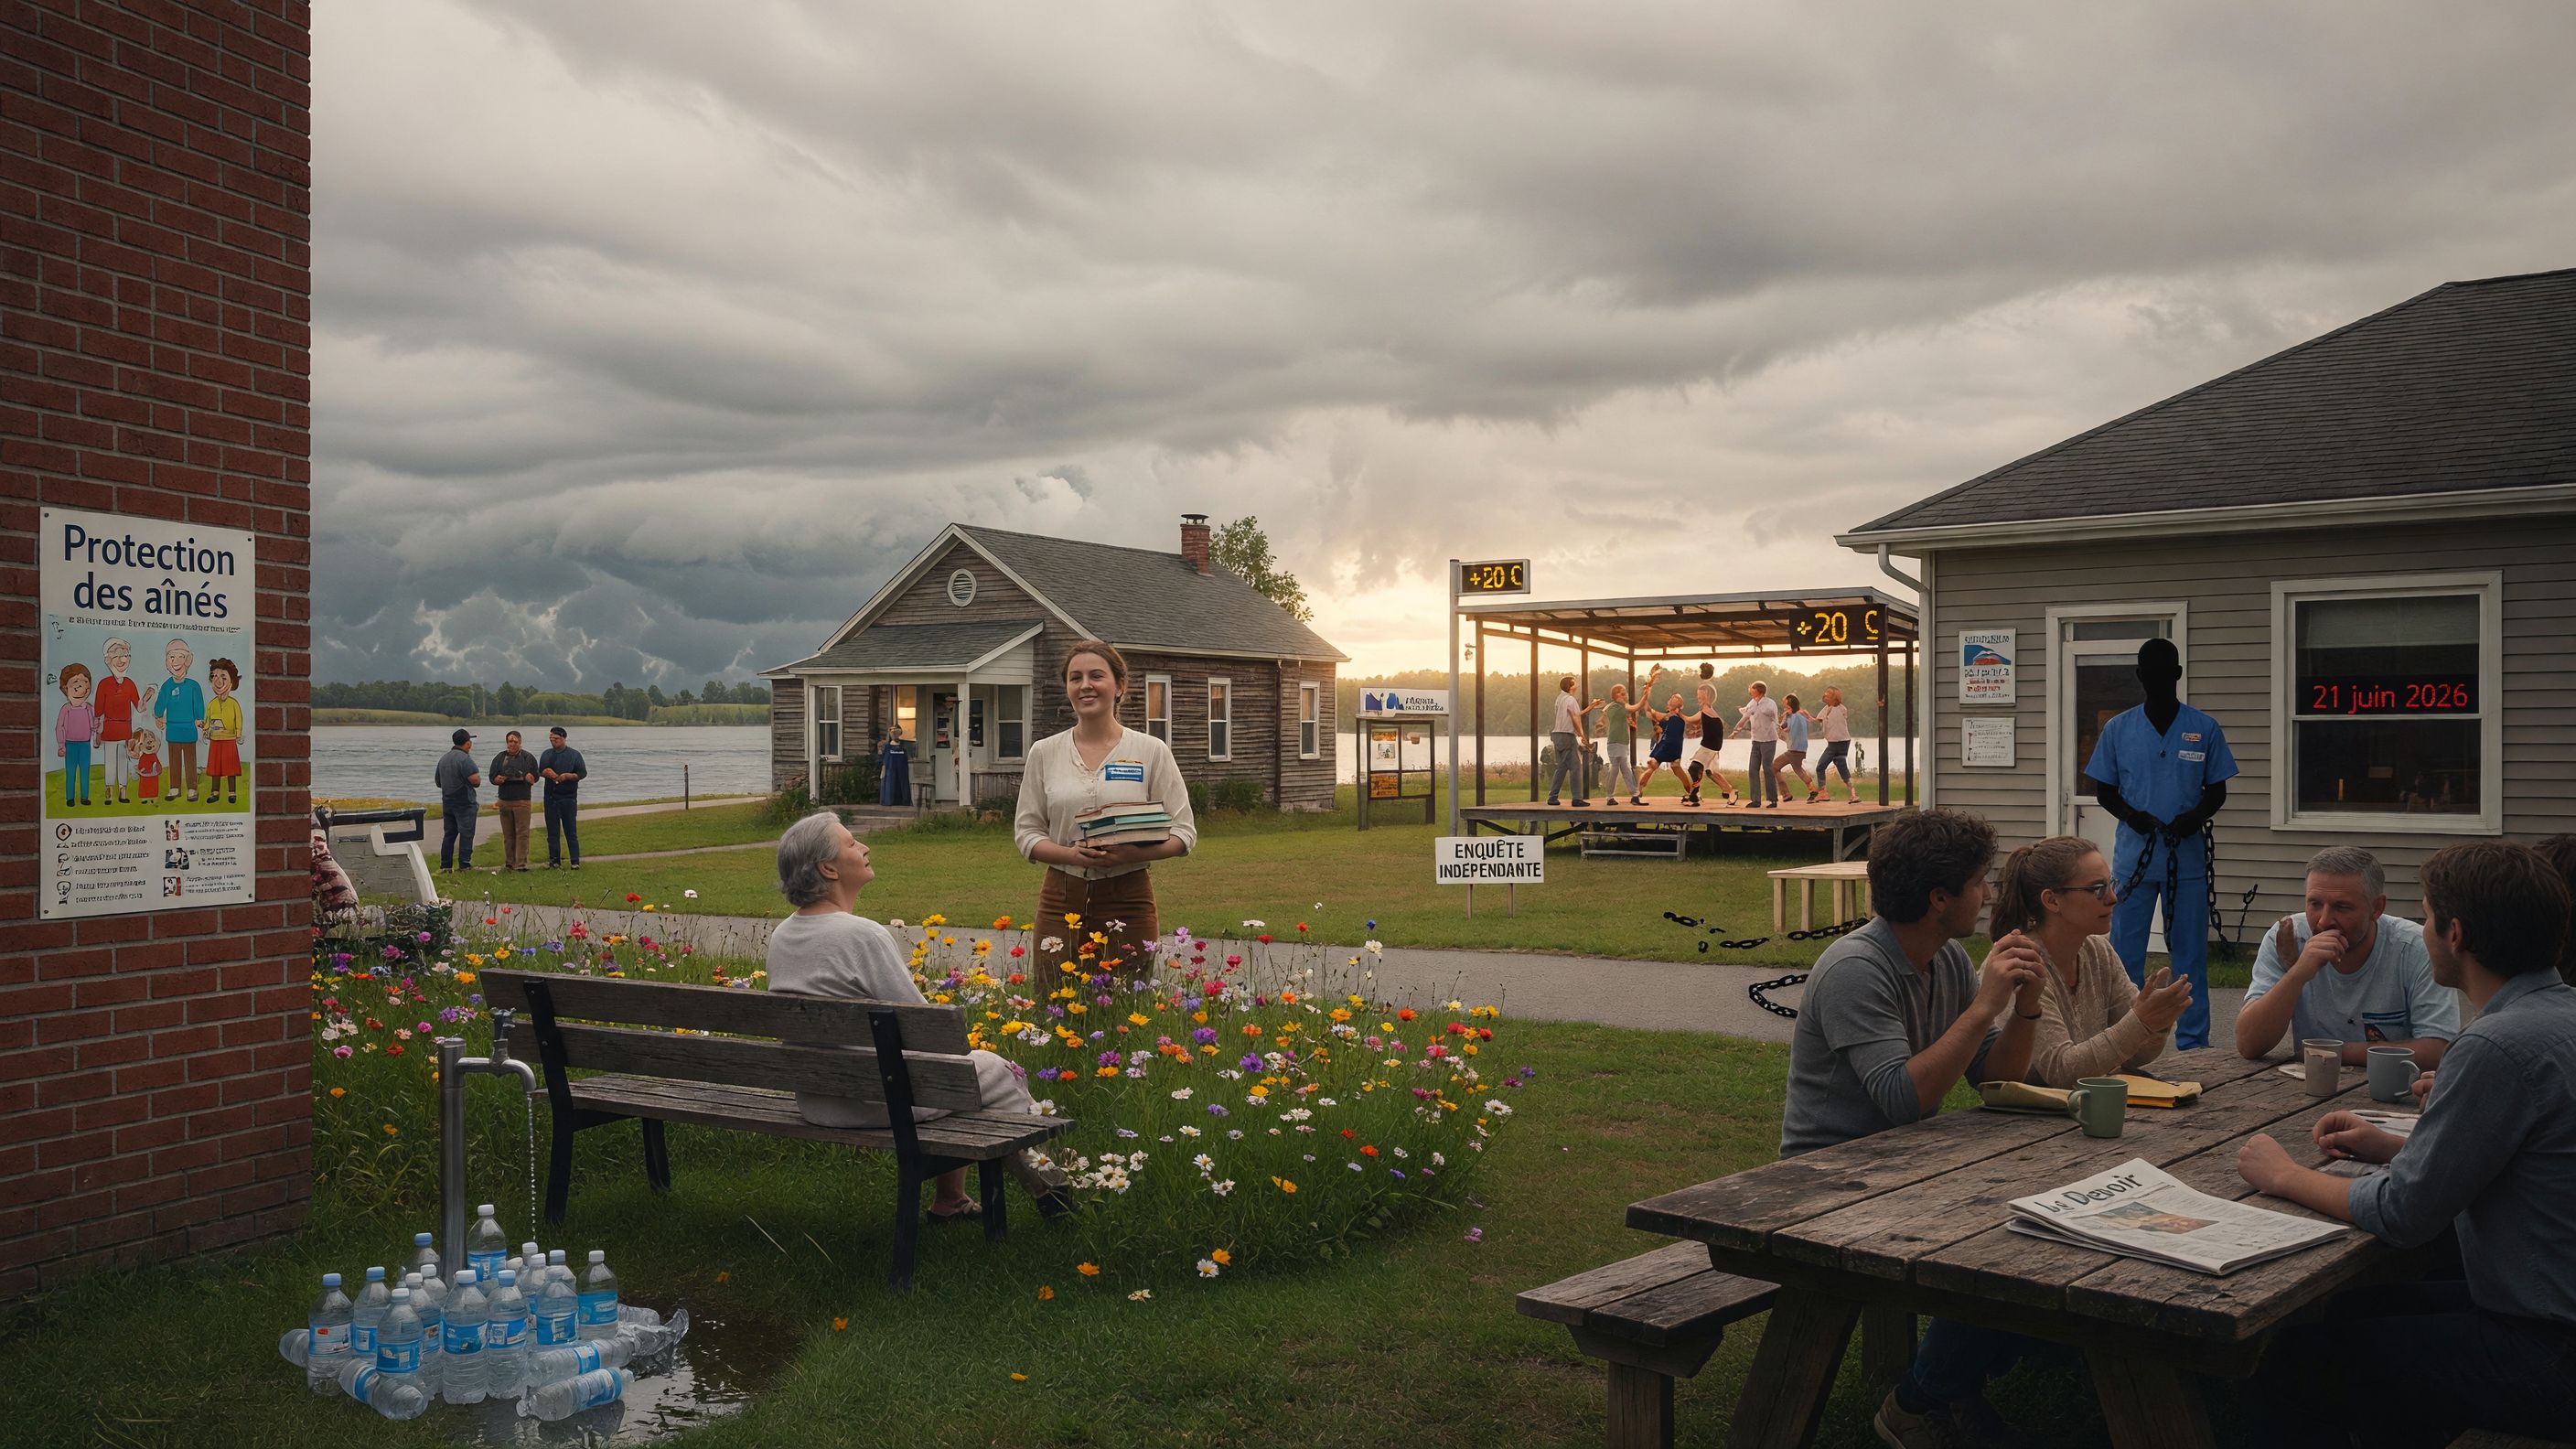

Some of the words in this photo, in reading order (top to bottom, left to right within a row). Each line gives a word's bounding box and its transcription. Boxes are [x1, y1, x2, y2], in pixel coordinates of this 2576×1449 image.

[64, 524, 235, 576] Protection
[1469, 565, 1506, 589] +20
[73, 571, 133, 612] des
[145, 577, 228, 618] aînés
[1797, 611, 1848, 643] +20
[2313, 685, 2338, 709] 21
[2347, 685, 2396, 714] juin
[2405, 683, 2468, 708] 2026
[1454, 839, 1525, 860] ENQUÊTE
[2062, 1174, 2143, 1206] Devoir
